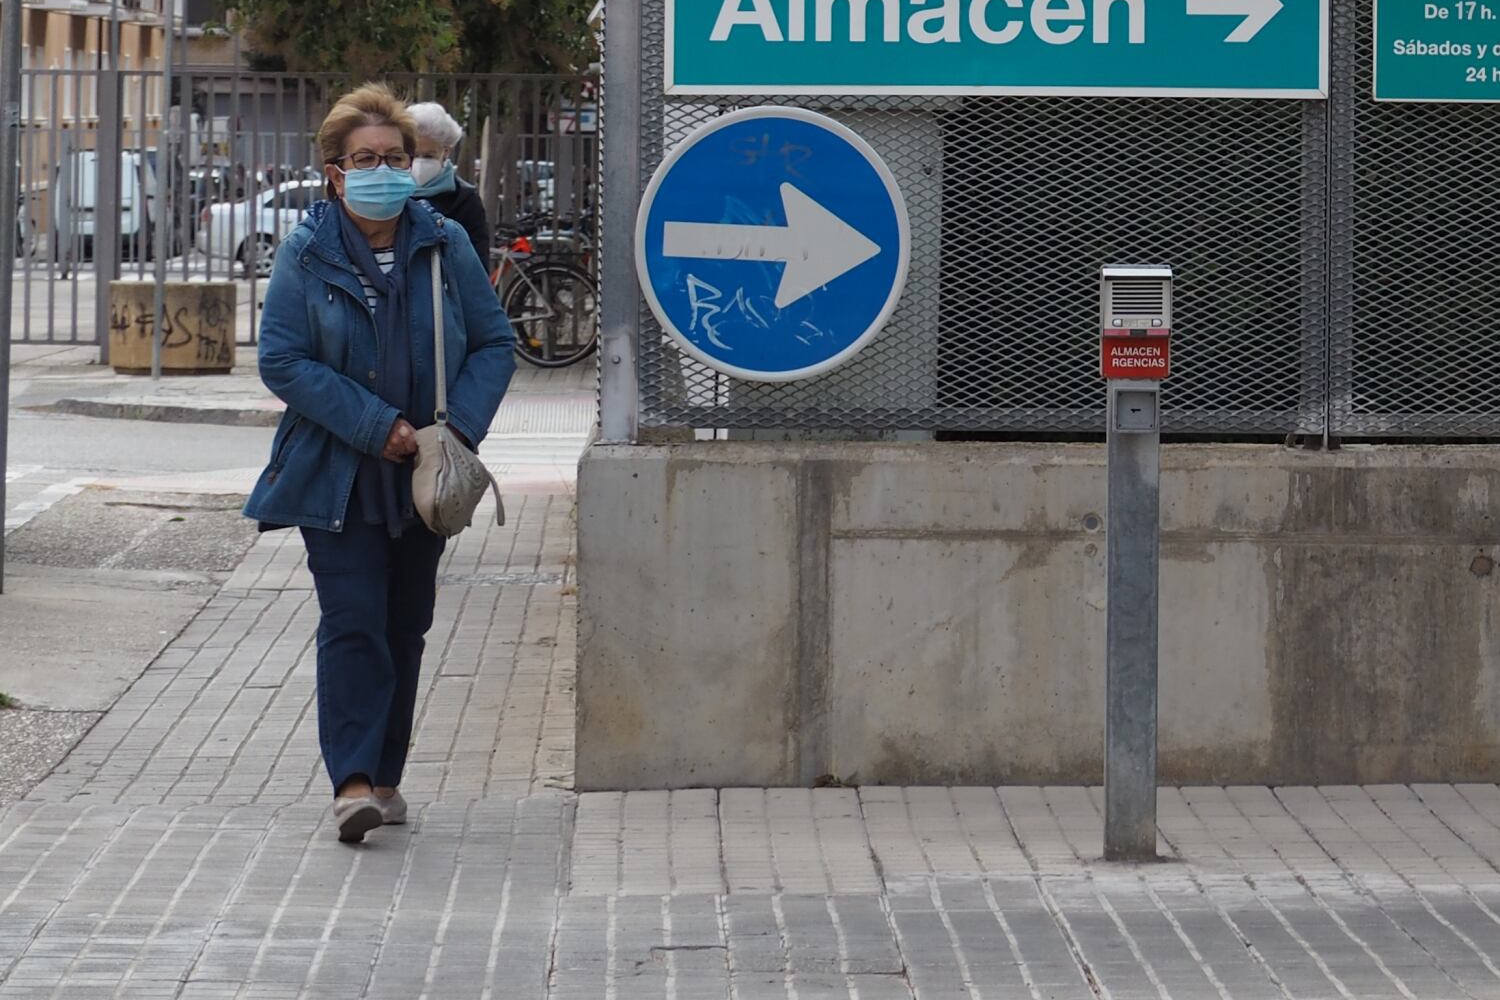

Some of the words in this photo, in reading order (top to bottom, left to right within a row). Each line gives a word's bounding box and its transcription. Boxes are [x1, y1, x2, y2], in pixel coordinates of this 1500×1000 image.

[1424, 4, 1449, 19] De
[1454, 1, 1477, 20] 17
[1481, 5, 1497, 19] h.
[1393, 38, 1472, 56] Sábados
[1477, 43, 1487, 59] y
[1465, 67, 1487, 82] 24
[1111, 347, 1160, 356] ALMACEN
[1112, 358, 1165, 368] RGENCIAS
